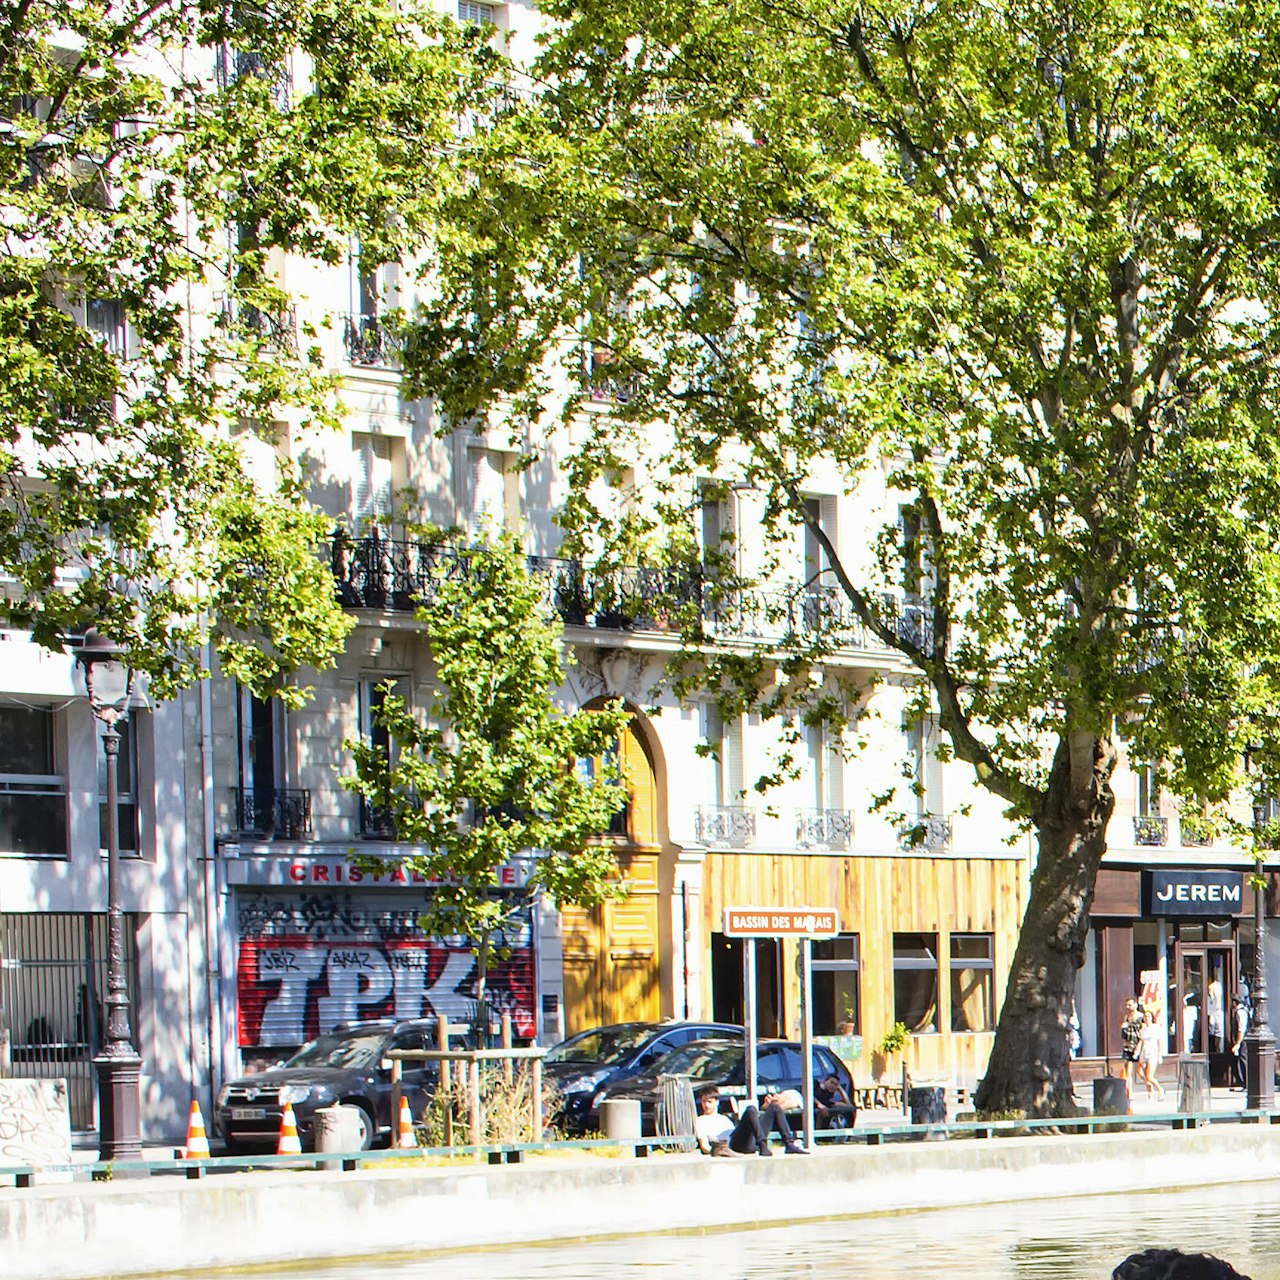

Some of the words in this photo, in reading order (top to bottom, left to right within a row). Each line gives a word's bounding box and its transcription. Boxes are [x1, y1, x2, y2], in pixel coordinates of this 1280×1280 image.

[1156, 884, 1240, 902] JEREM
[733, 916, 769, 929] BASSIN
[771, 916, 790, 929] DES
[793, 916, 832, 930] MAAIS
